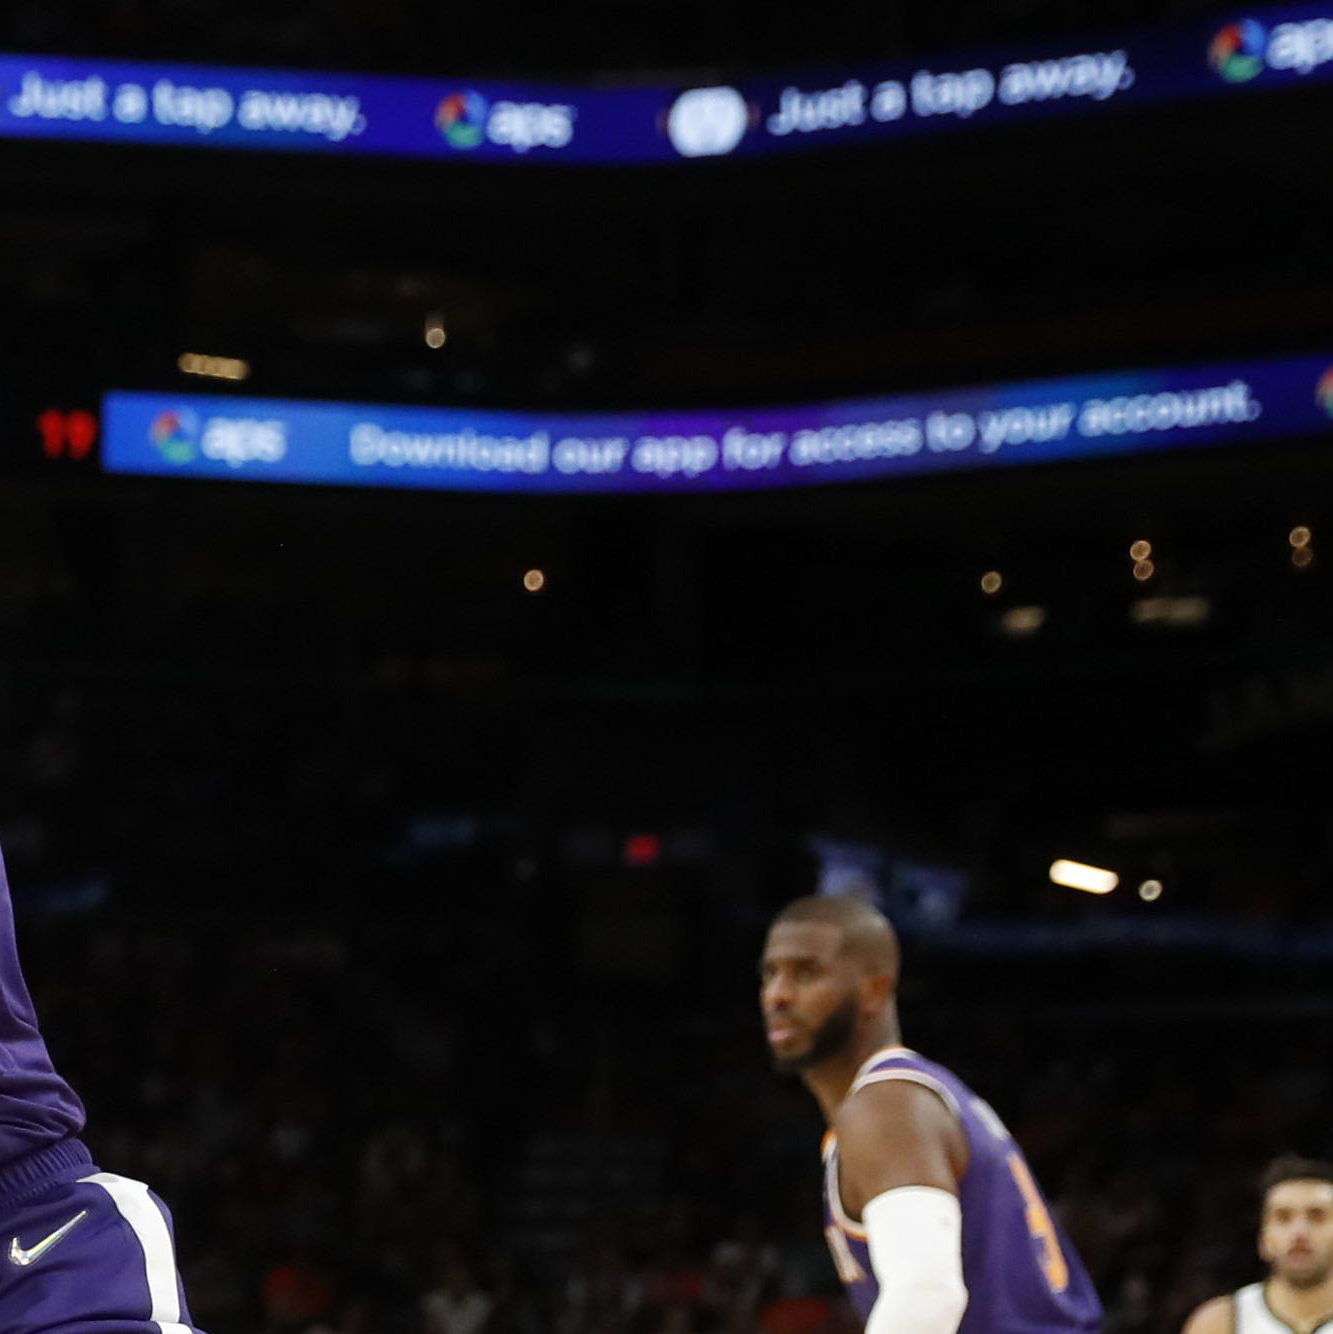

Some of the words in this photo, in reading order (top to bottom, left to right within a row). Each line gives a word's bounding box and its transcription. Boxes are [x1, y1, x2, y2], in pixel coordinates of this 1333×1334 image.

[9, 70, 109, 121] Just
[112, 83, 148, 123] a
[152, 79, 233, 134] tap
[237, 89, 367, 142] away.
[488, 101, 576, 153] aps
[767, 78, 867, 136] Just
[870, 80, 906, 122] a
[911, 69, 994, 118] tap
[999, 49, 1134, 105] away.
[200, 417, 286, 468] aps
[350, 423, 551, 474] Download
[552, 437, 630, 474] our
[631, 435, 719, 479] app
[722, 426, 786, 470] for
[789, 417, 924, 466] access
[926, 410, 976, 452] to
[978, 402, 1077, 454] your
[1078, 380, 1263, 438] account.
